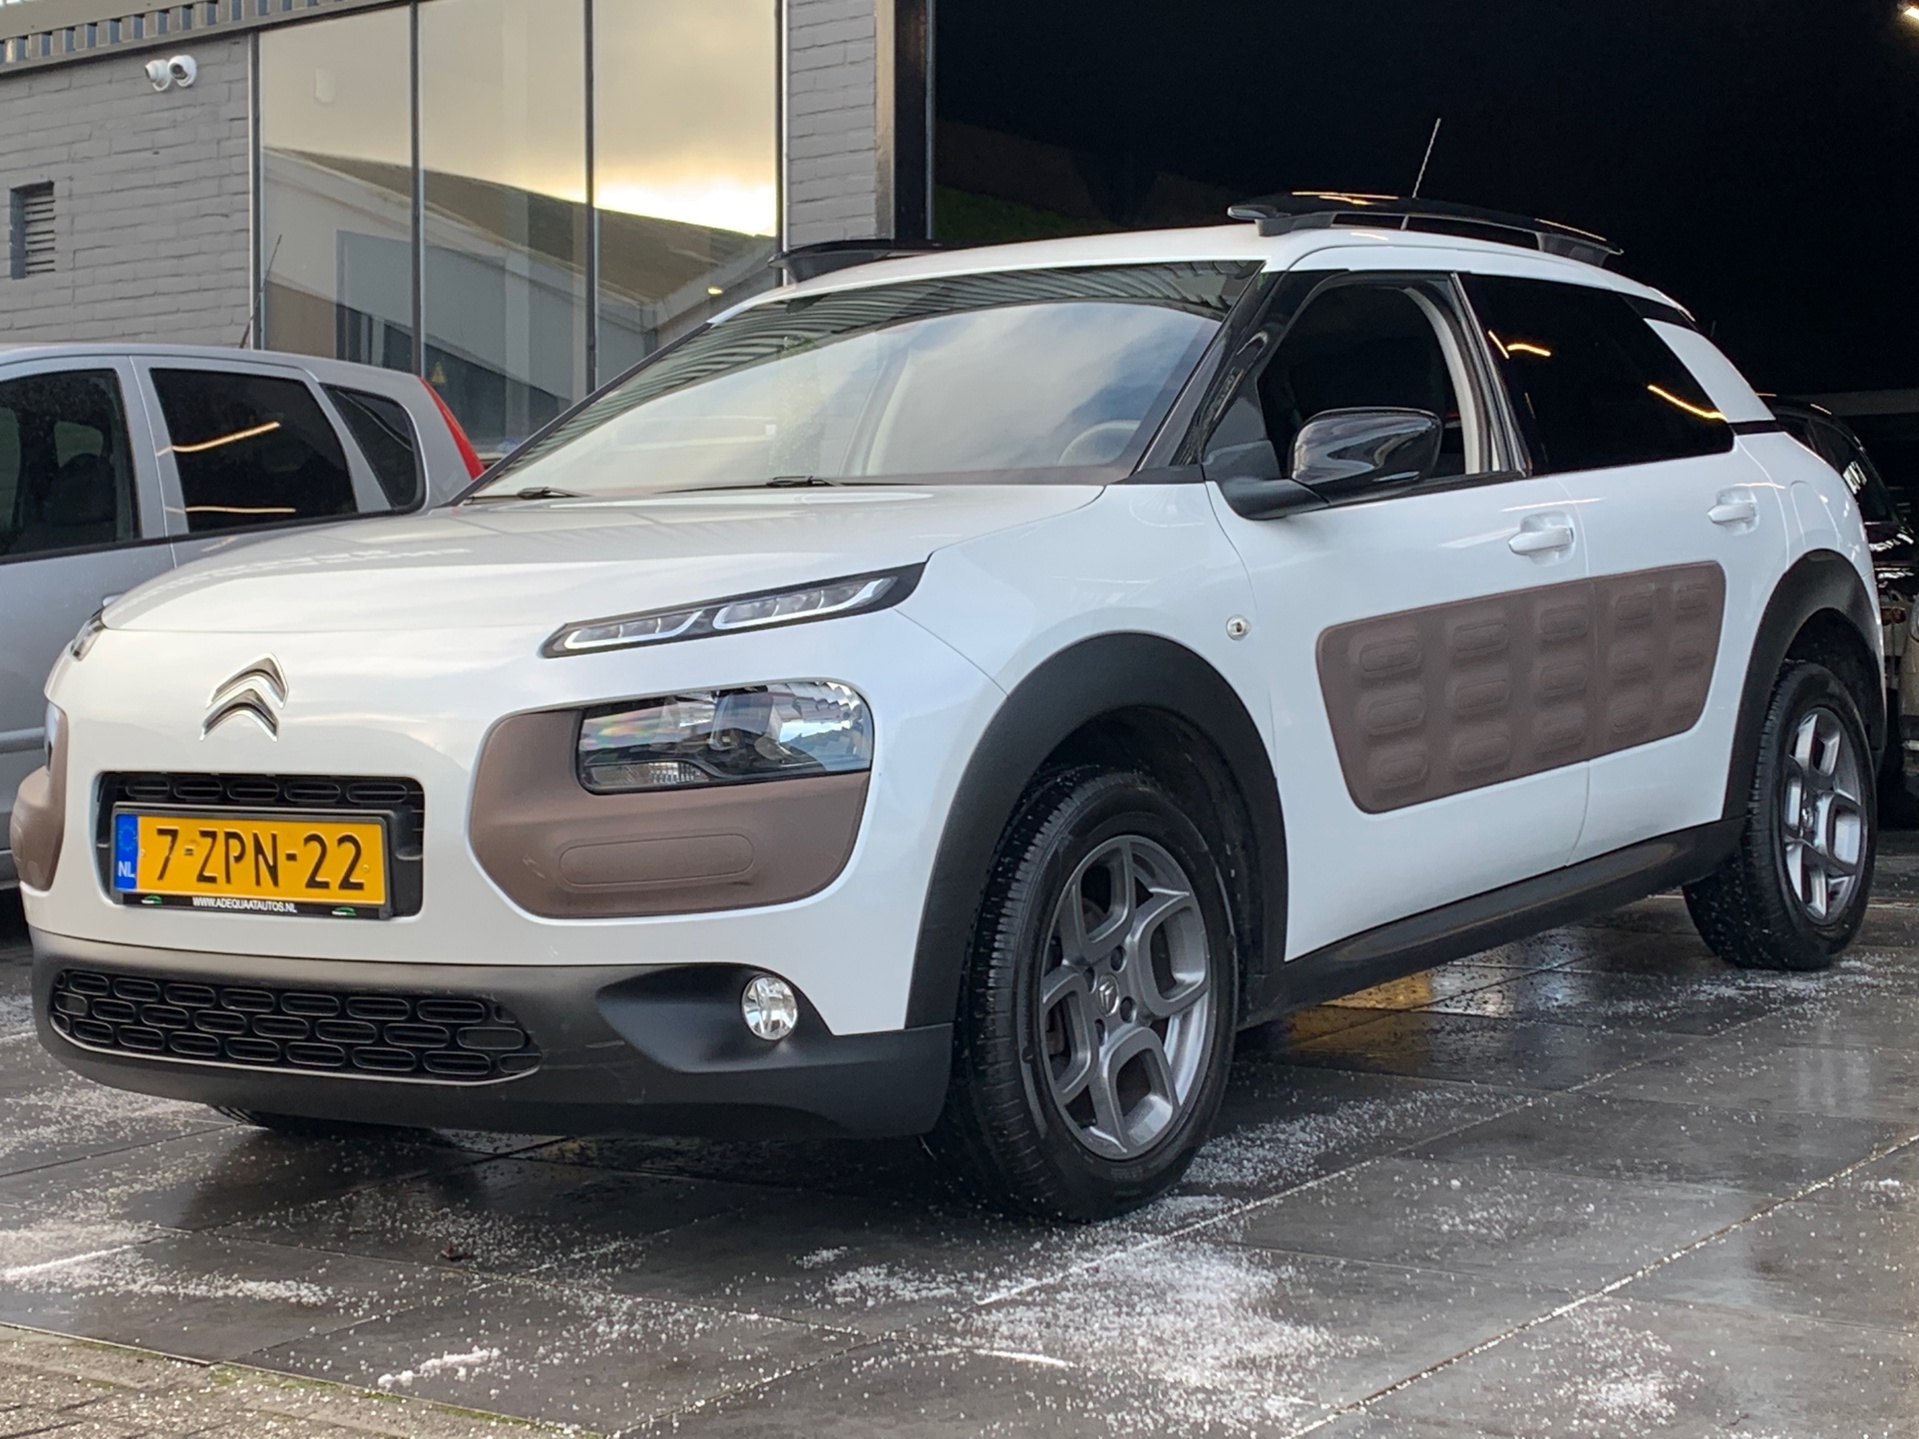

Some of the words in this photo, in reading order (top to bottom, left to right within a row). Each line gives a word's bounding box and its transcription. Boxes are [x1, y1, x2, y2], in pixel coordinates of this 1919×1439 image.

[156, 827, 365, 890] 7-ZPN-22
[118, 860, 136, 878] NL
[192, 896, 297, 913] WWW.ADEQUAATAUTOS.NL
